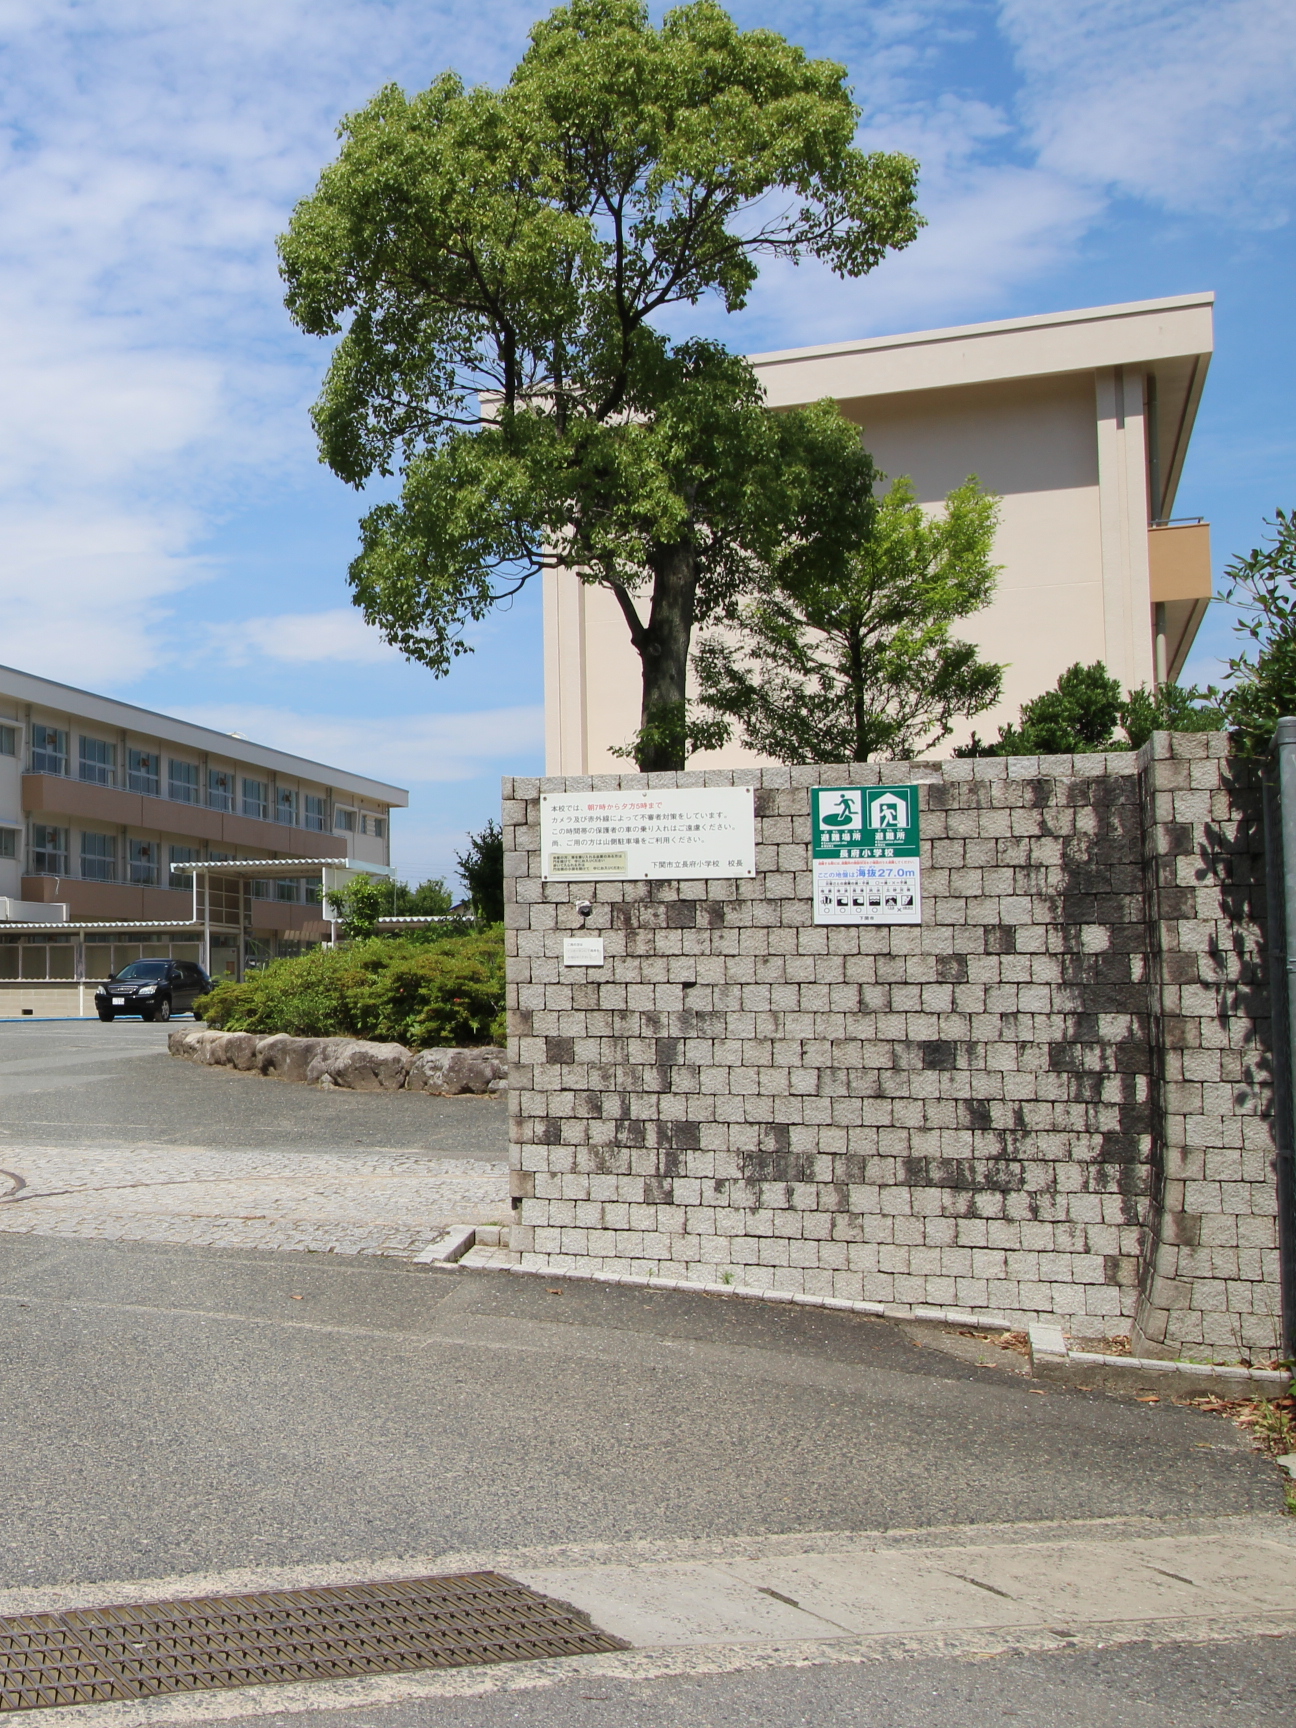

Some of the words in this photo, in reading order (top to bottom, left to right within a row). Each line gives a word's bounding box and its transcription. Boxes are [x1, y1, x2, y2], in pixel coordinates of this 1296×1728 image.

[551, 812, 727, 824] カメラ及び赤外線によって不審者対策をしています。
[552, 824, 735, 835] この時間帯の保護者の車の乗り入れはご遠慮ください。
[821, 832, 861, 842] 避難場所
[875, 831, 905, 840] 避難所
[552, 836, 705, 847] 尚、ご用の方は山側駐車場をご利用ください。
[840, 848, 894, 858] 長府小学校
[651, 860, 720, 869] 下関市立長府小学校
[728, 859, 743, 867] 校長
